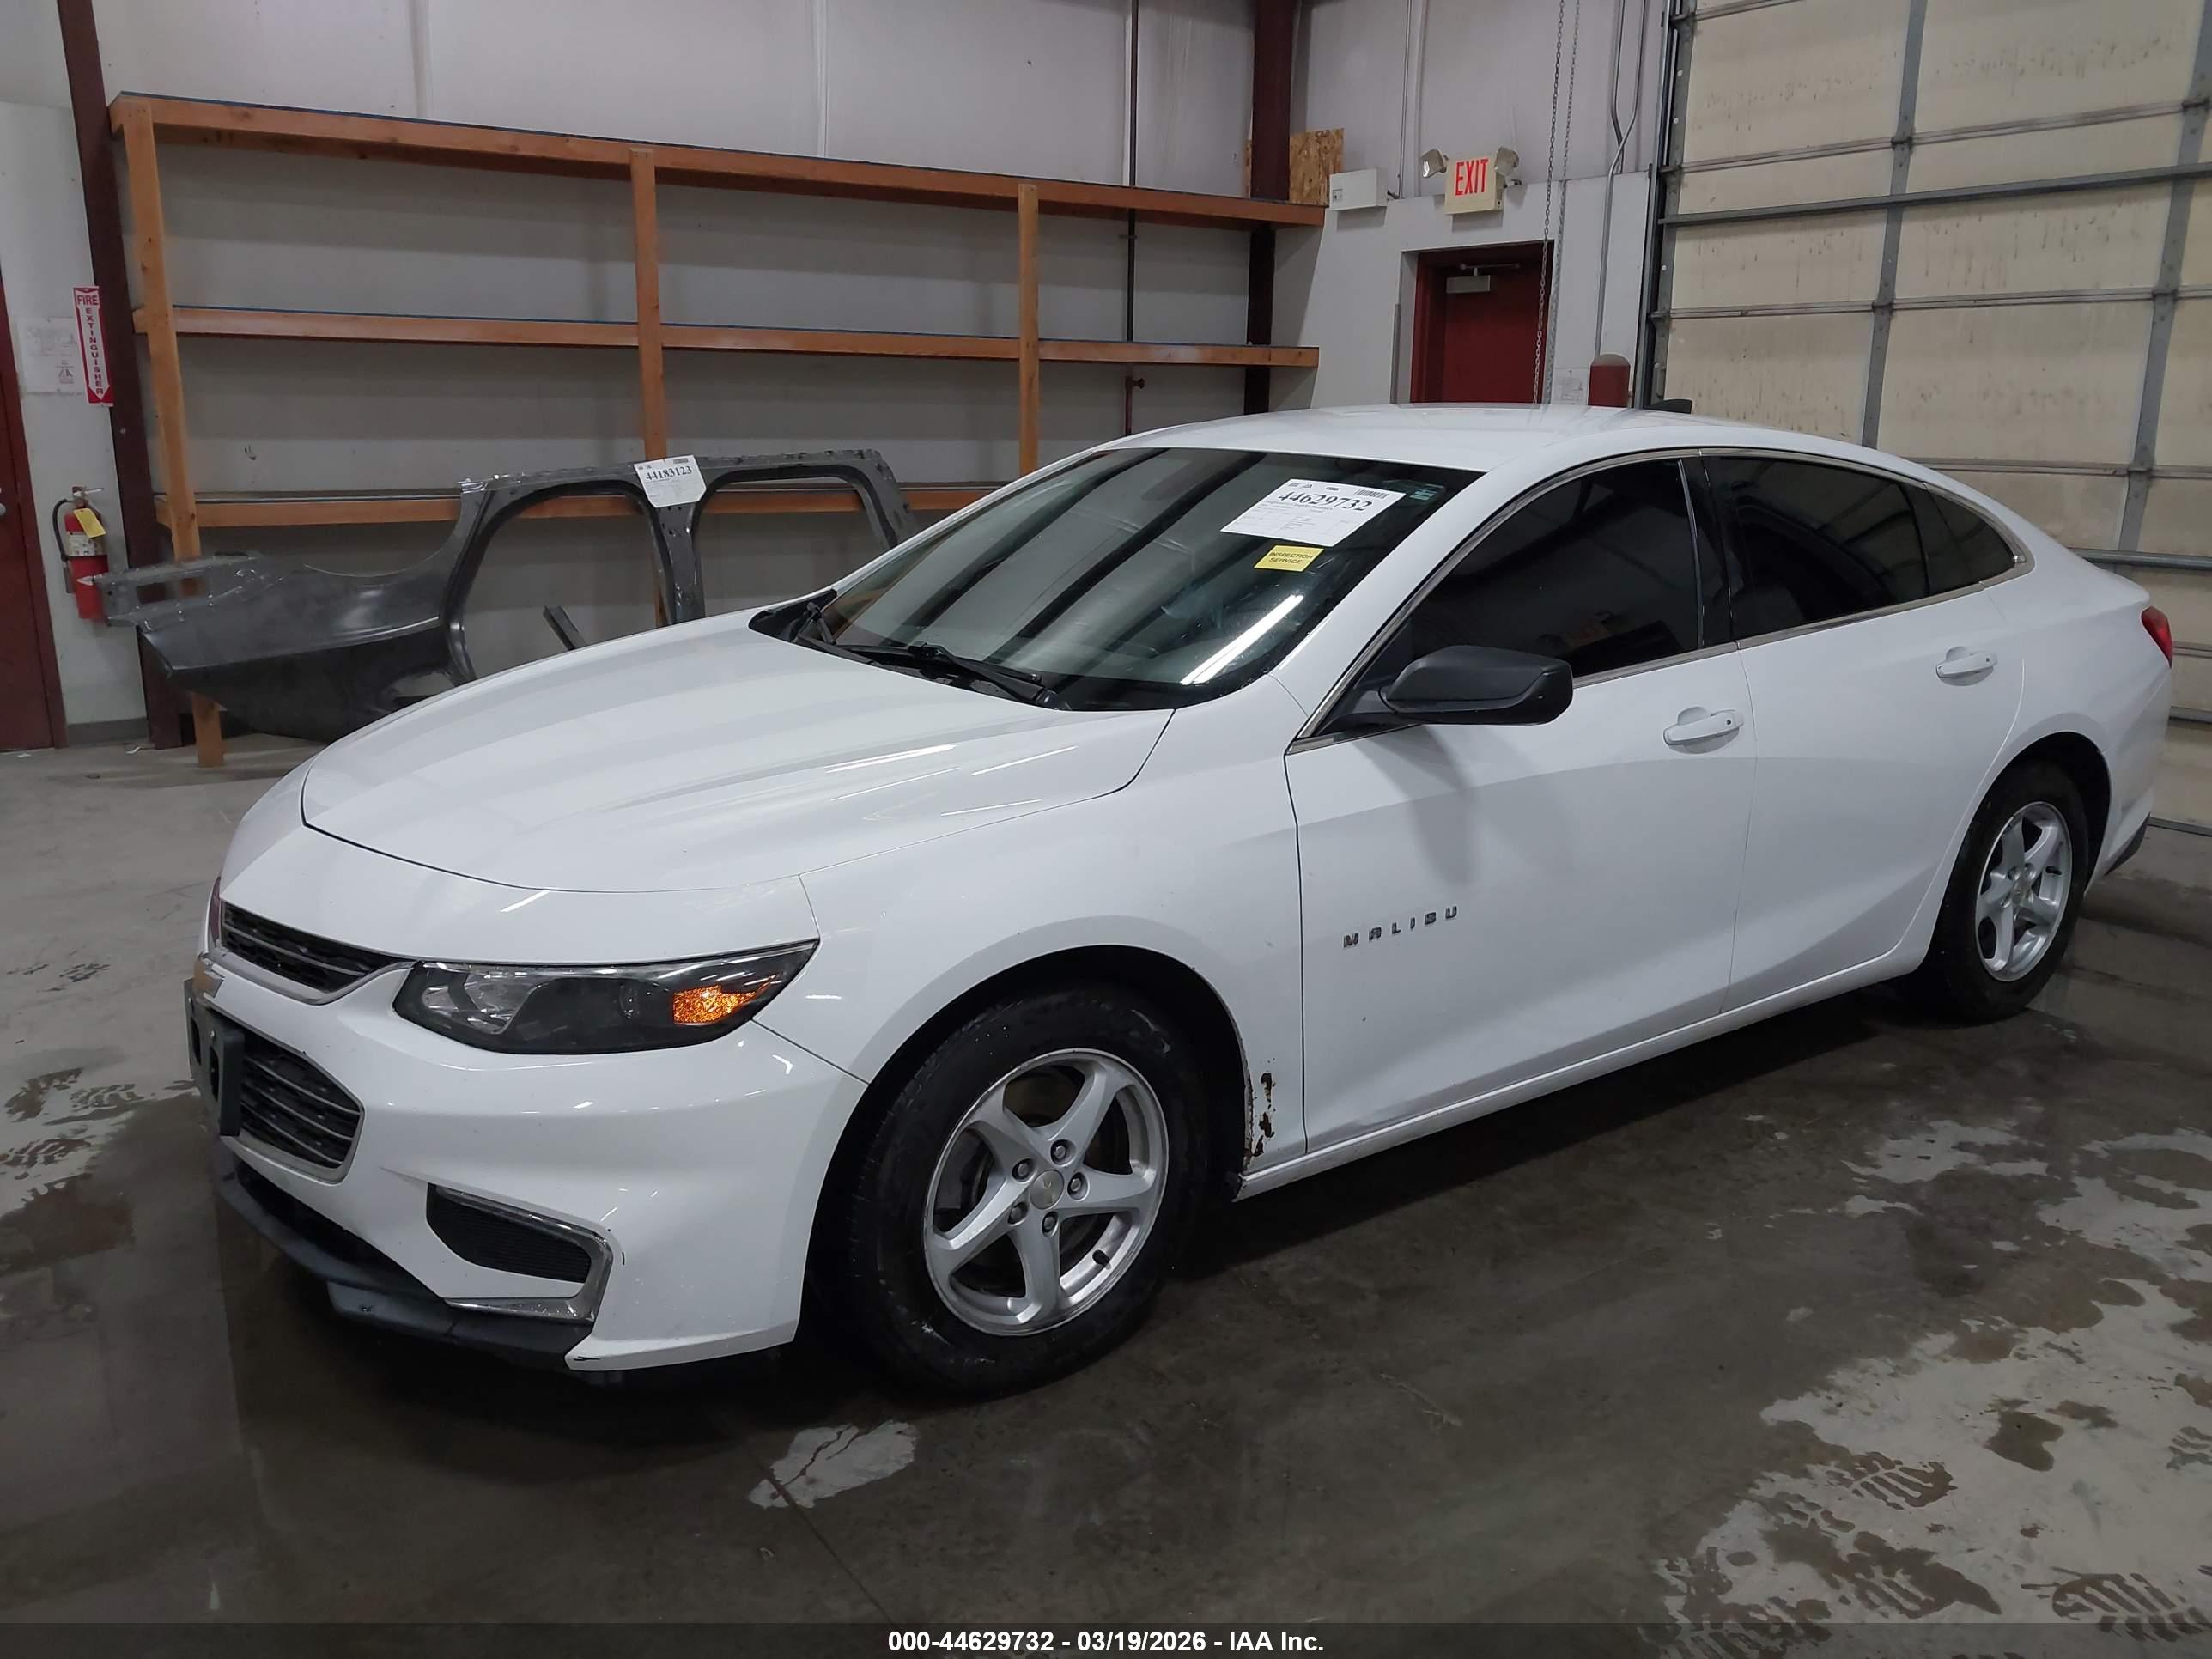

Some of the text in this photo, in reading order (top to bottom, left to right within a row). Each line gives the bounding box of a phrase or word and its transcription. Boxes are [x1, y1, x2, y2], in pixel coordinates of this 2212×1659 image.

[1455, 159, 1488, 196] EXIT
[77, 295, 99, 306] FIRE
[86, 307, 104, 394] EXTINGUISHER
[646, 465, 692, 481] 44183123
[1278, 491, 1373, 512] 44629732
[1343, 906, 1457, 948] MALIBU
